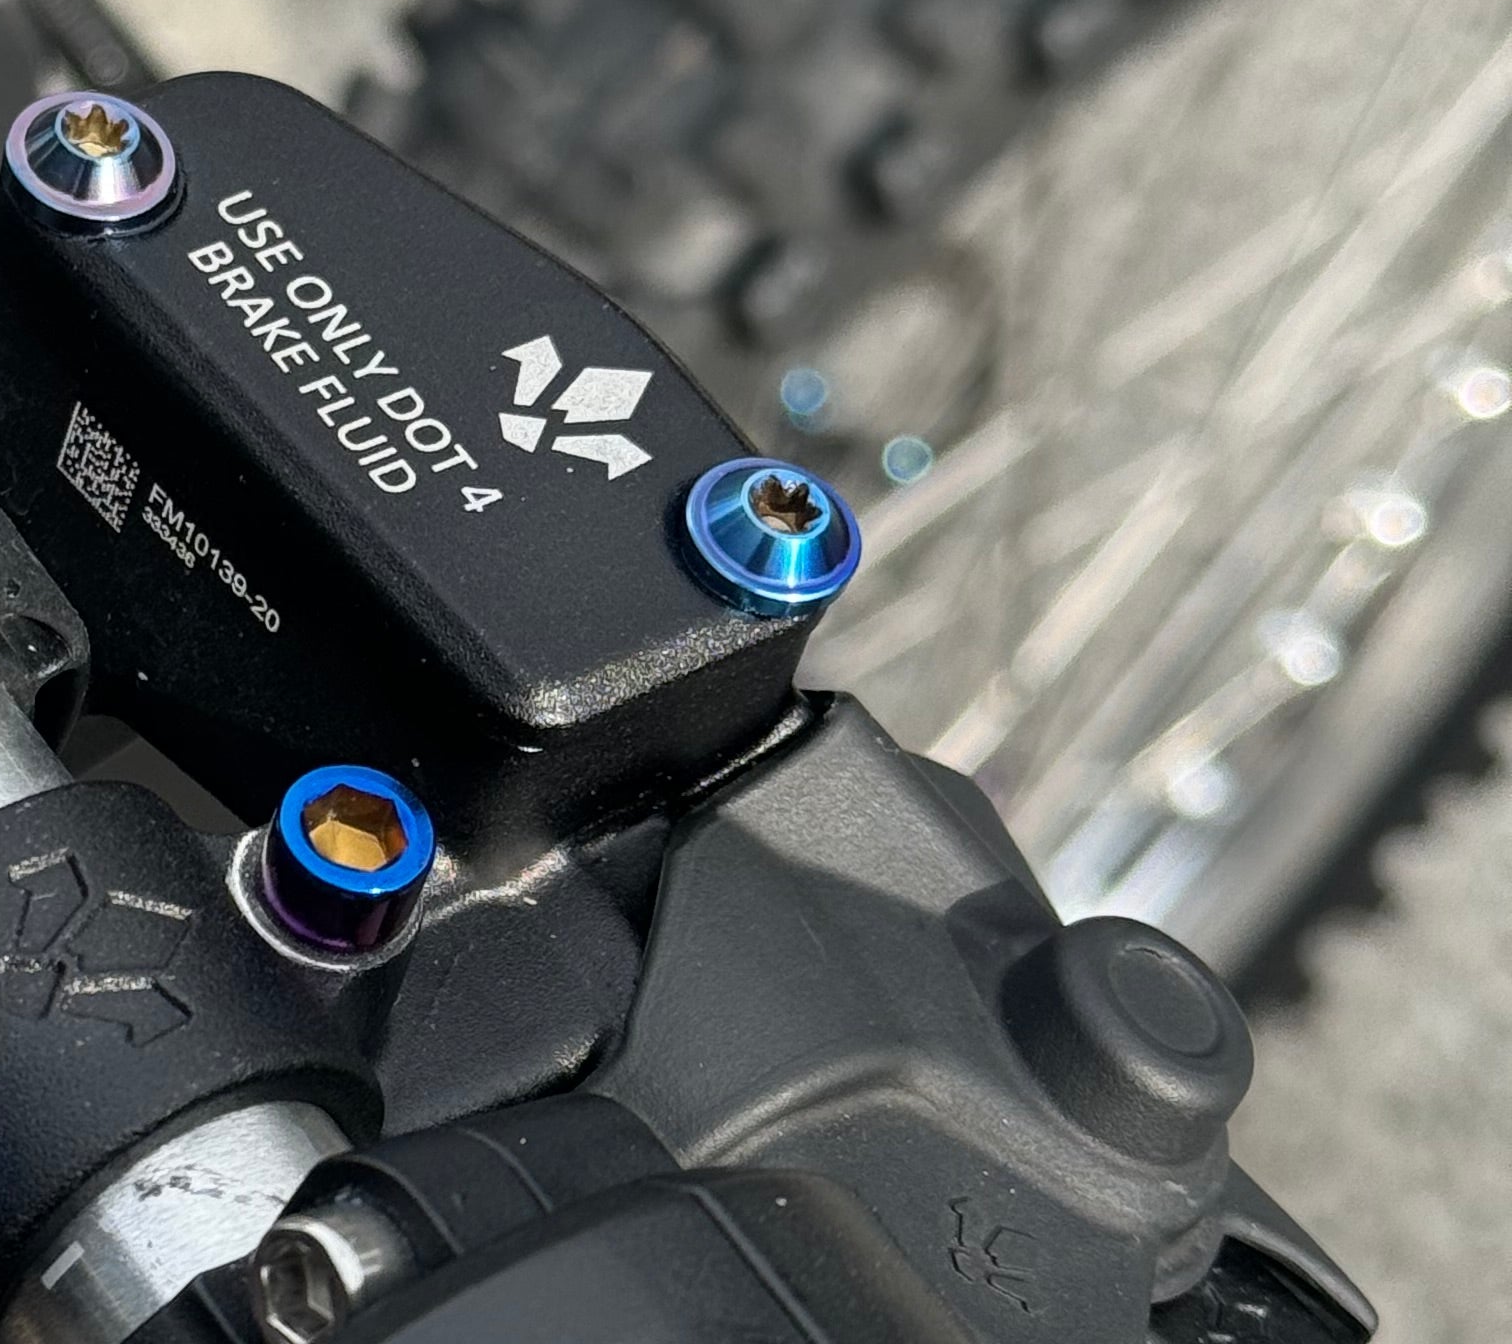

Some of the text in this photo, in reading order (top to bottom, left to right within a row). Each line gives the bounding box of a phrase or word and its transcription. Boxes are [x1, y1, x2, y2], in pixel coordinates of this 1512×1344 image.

[187, 240, 417, 494] BRAKE FLUID
[218, 189, 504, 513] USE ONLY DOT 4
[147, 482, 281, 633] FM10139-20
